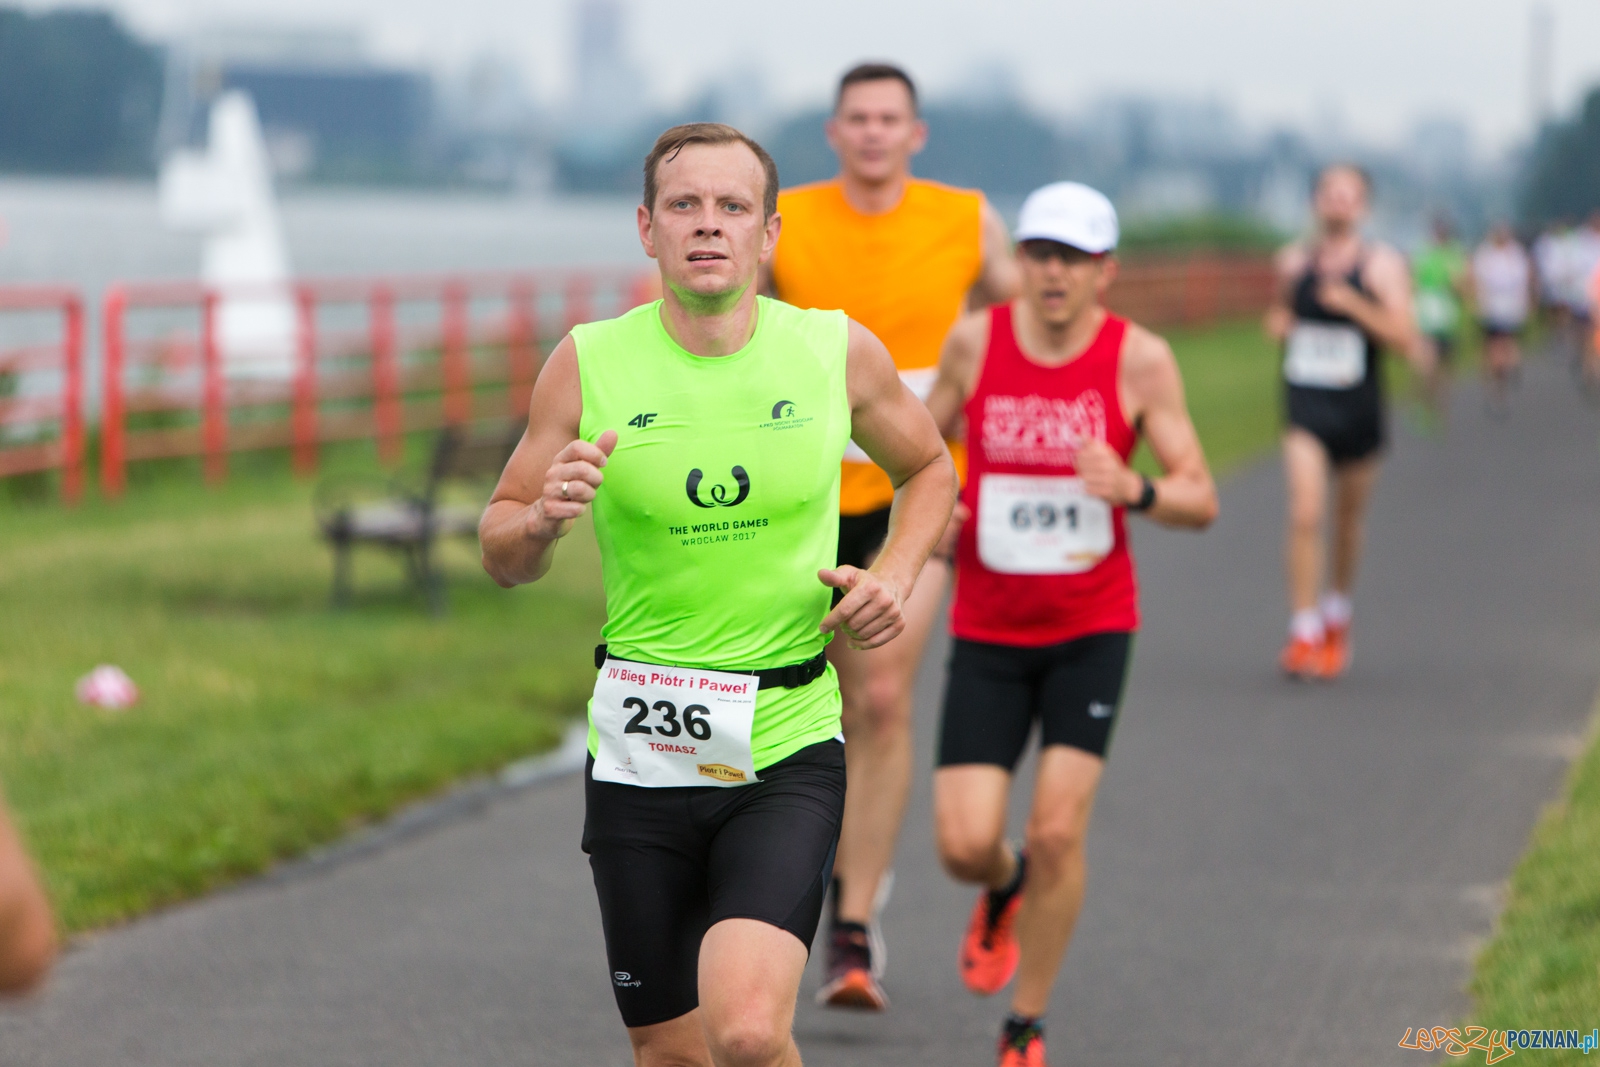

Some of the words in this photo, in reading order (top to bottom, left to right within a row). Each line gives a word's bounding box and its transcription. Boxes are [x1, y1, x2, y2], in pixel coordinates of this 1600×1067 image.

[627, 413, 658, 428] 4F
[1010, 501, 1079, 532] 691
[669, 525, 688, 535] THE
[691, 521, 729, 533] WORLD
[733, 518, 769, 529] GAMES
[680, 534, 729, 546] WROCŁAW
[732, 531, 757, 541] 2017
[607, 667, 619, 679] IV
[620, 670, 646, 686] Bieg
[650, 673, 685, 688] Piotr
[689, 677, 694, 688] i
[699, 678, 748, 694] Paweł
[622, 696, 712, 741] 236
[648, 742, 697, 755] TOMASZ
[699, 765, 717, 774] Piotr
